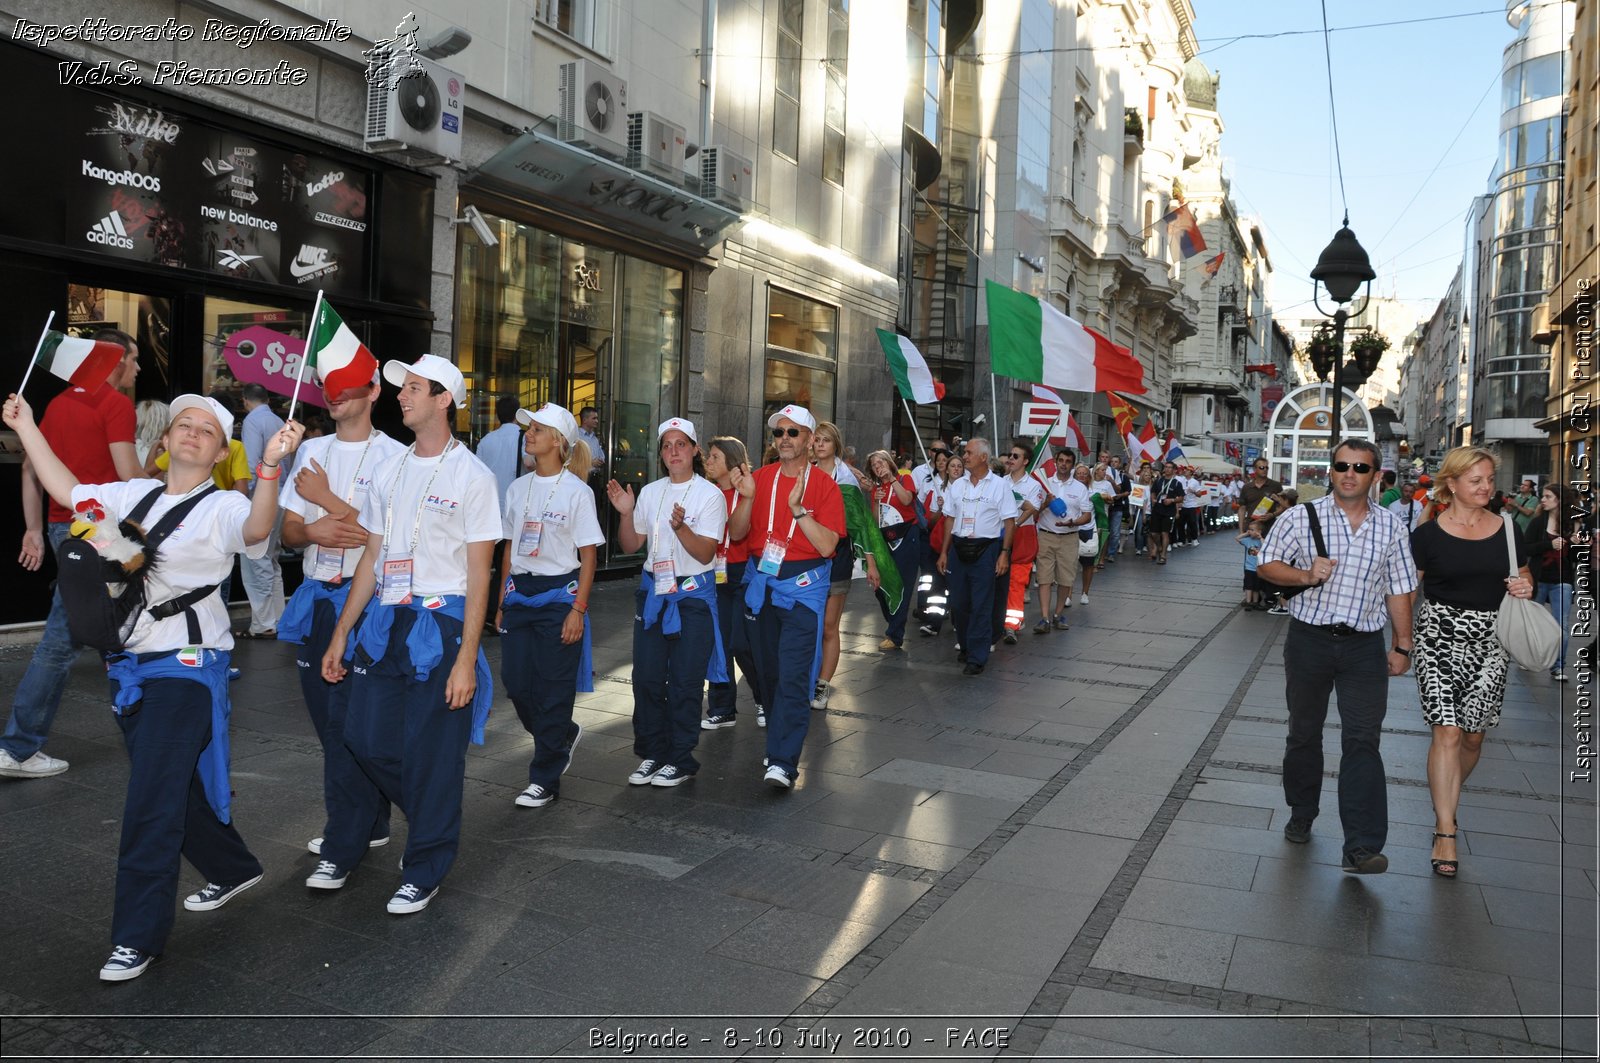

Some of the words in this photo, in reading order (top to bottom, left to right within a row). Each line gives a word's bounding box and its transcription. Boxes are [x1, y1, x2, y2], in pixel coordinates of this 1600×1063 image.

[448, 98, 458, 109] LG
[82, 160, 161, 192] KangaROOS
[514, 160, 567, 183] JEWELRY
[306, 171, 344, 197] lotto
[201, 205, 226, 220] new
[229, 209, 278, 231] balance
[316, 212, 366, 232] SKECHERS
[86, 231, 134, 249] adidas
[298, 244, 328, 264] NIKE
[428, 494, 458, 509] FACE
